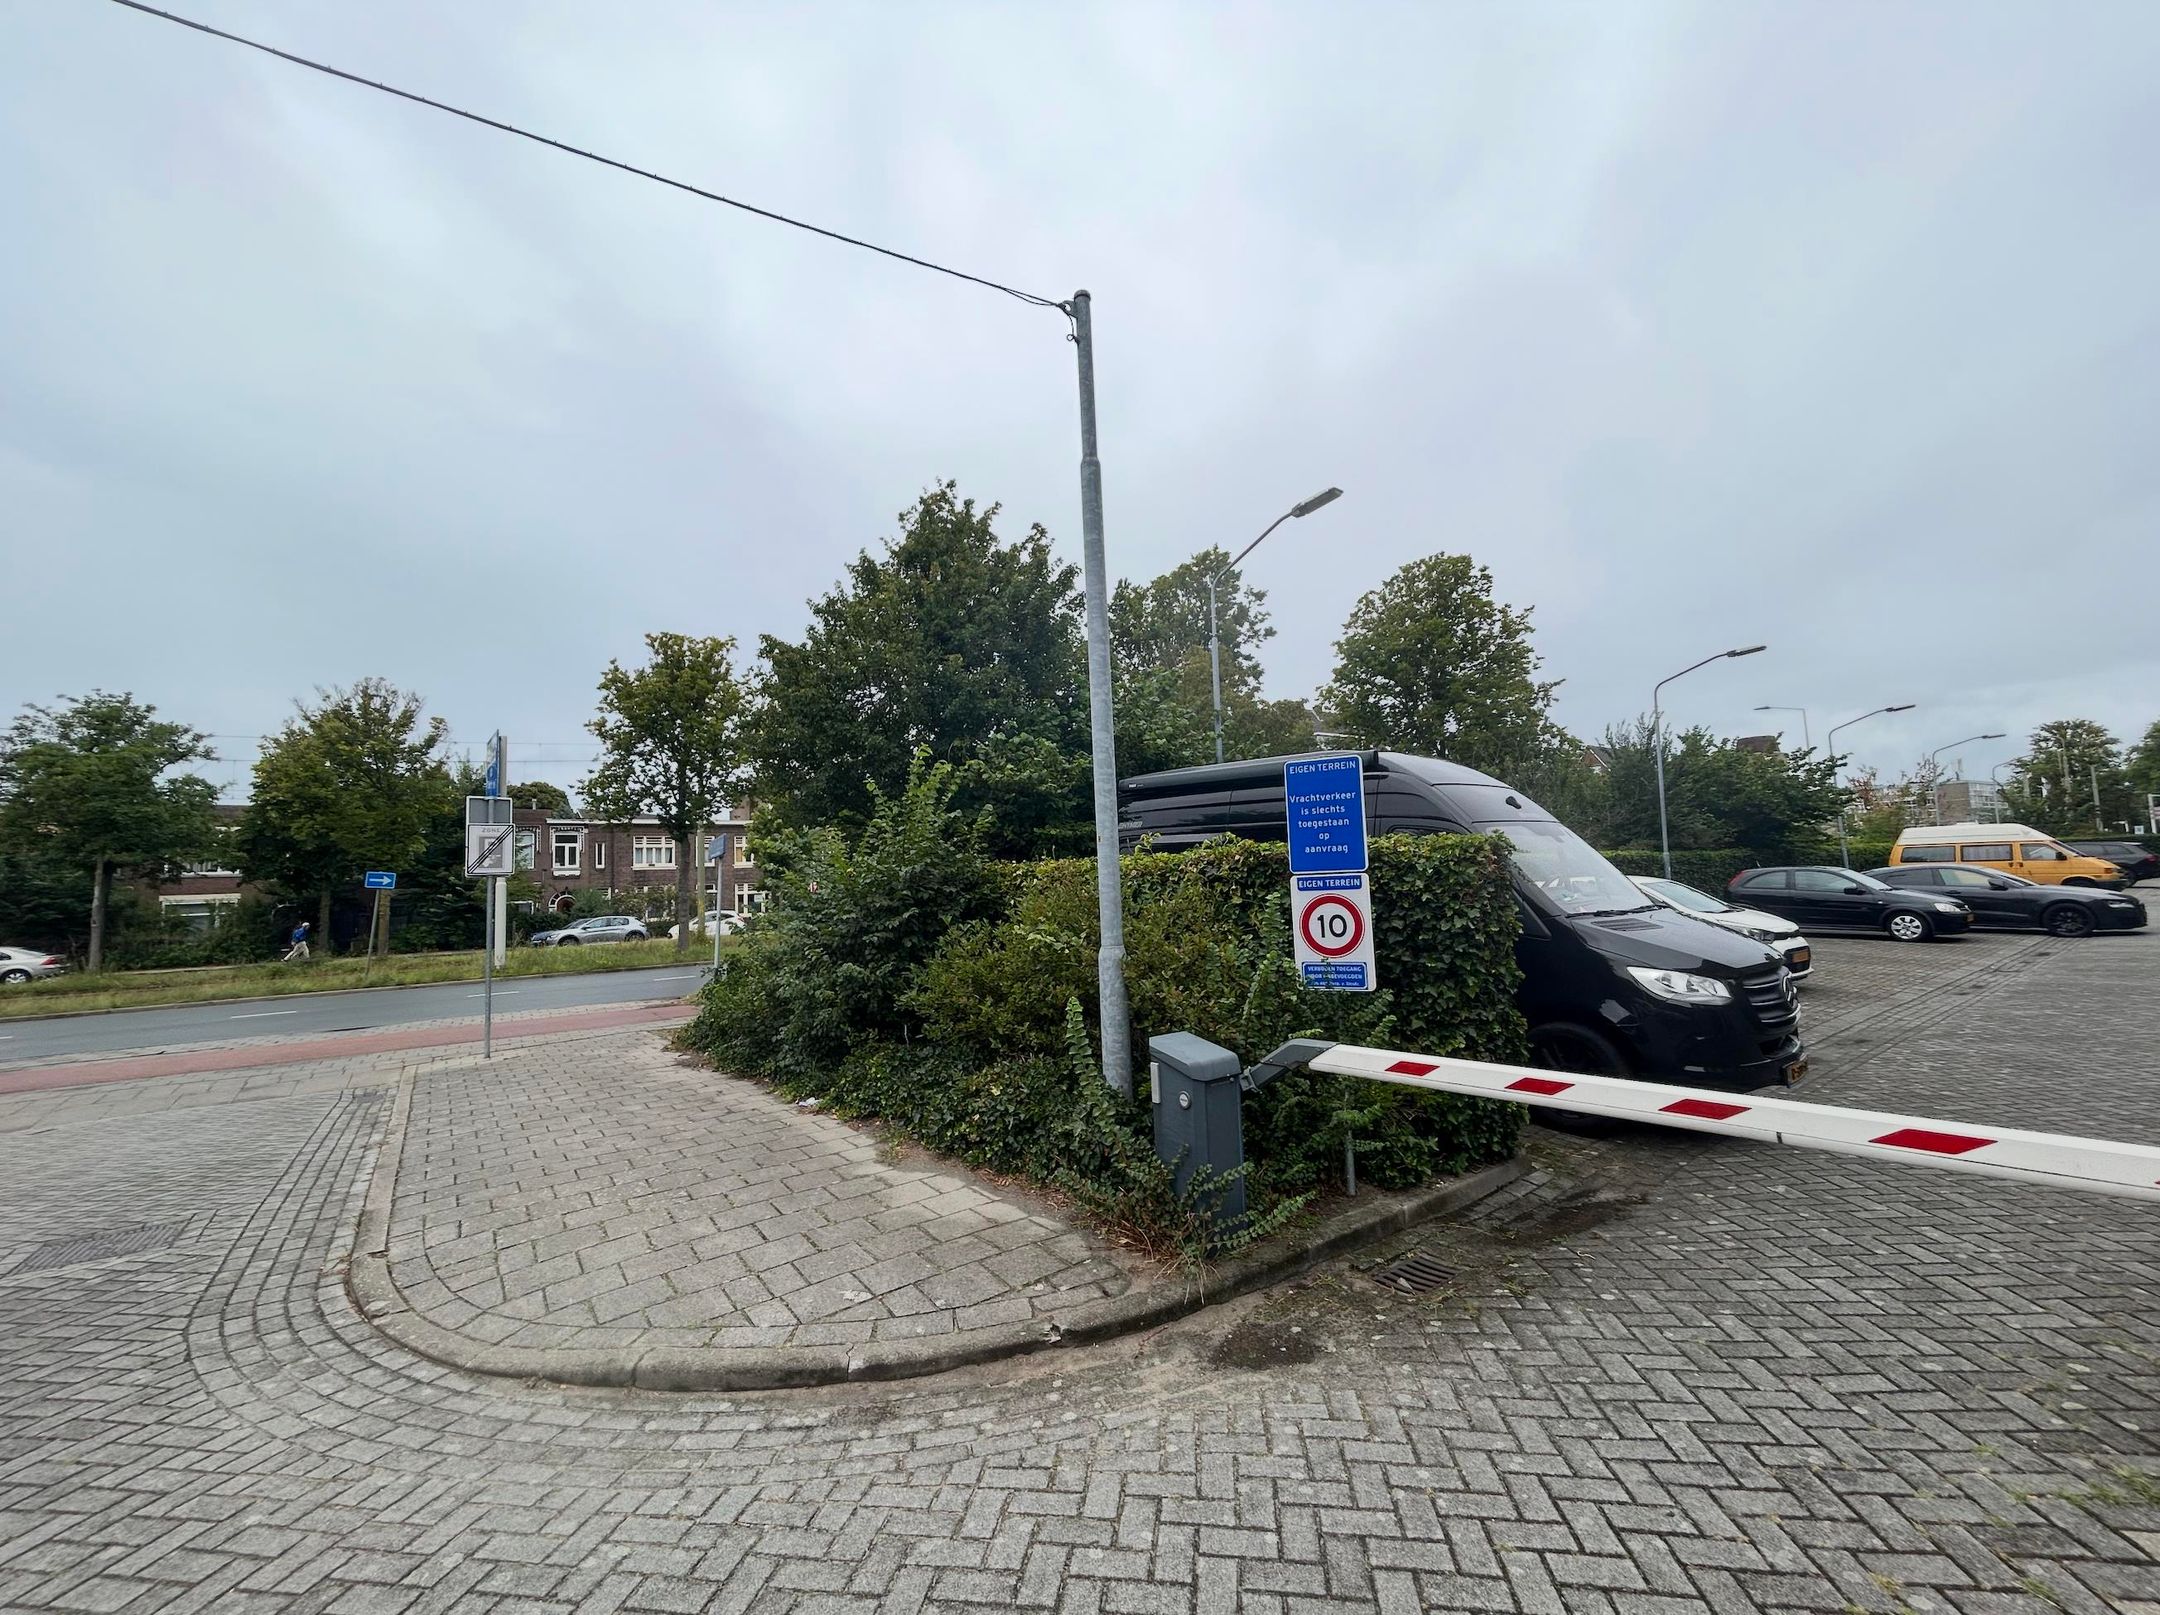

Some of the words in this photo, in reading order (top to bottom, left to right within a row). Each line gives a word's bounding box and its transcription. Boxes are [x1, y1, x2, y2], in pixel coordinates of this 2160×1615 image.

[1289, 764, 1316, 774] EIGEN
[1317, 760, 1356, 771] TERREIN
[1289, 791, 1356, 803] Vrachtverkeer
[1301, 807, 1309, 815] is
[1311, 805, 1346, 815] slechts
[1298, 818, 1350, 829] toegestaan
[1318, 832, 1330, 841] op
[1304, 844, 1349, 854] aanvraag
[1298, 879, 1323, 888] EIGEN
[1325, 878, 1361, 887] TERREIN
[1317, 914, 1348, 938] 10
